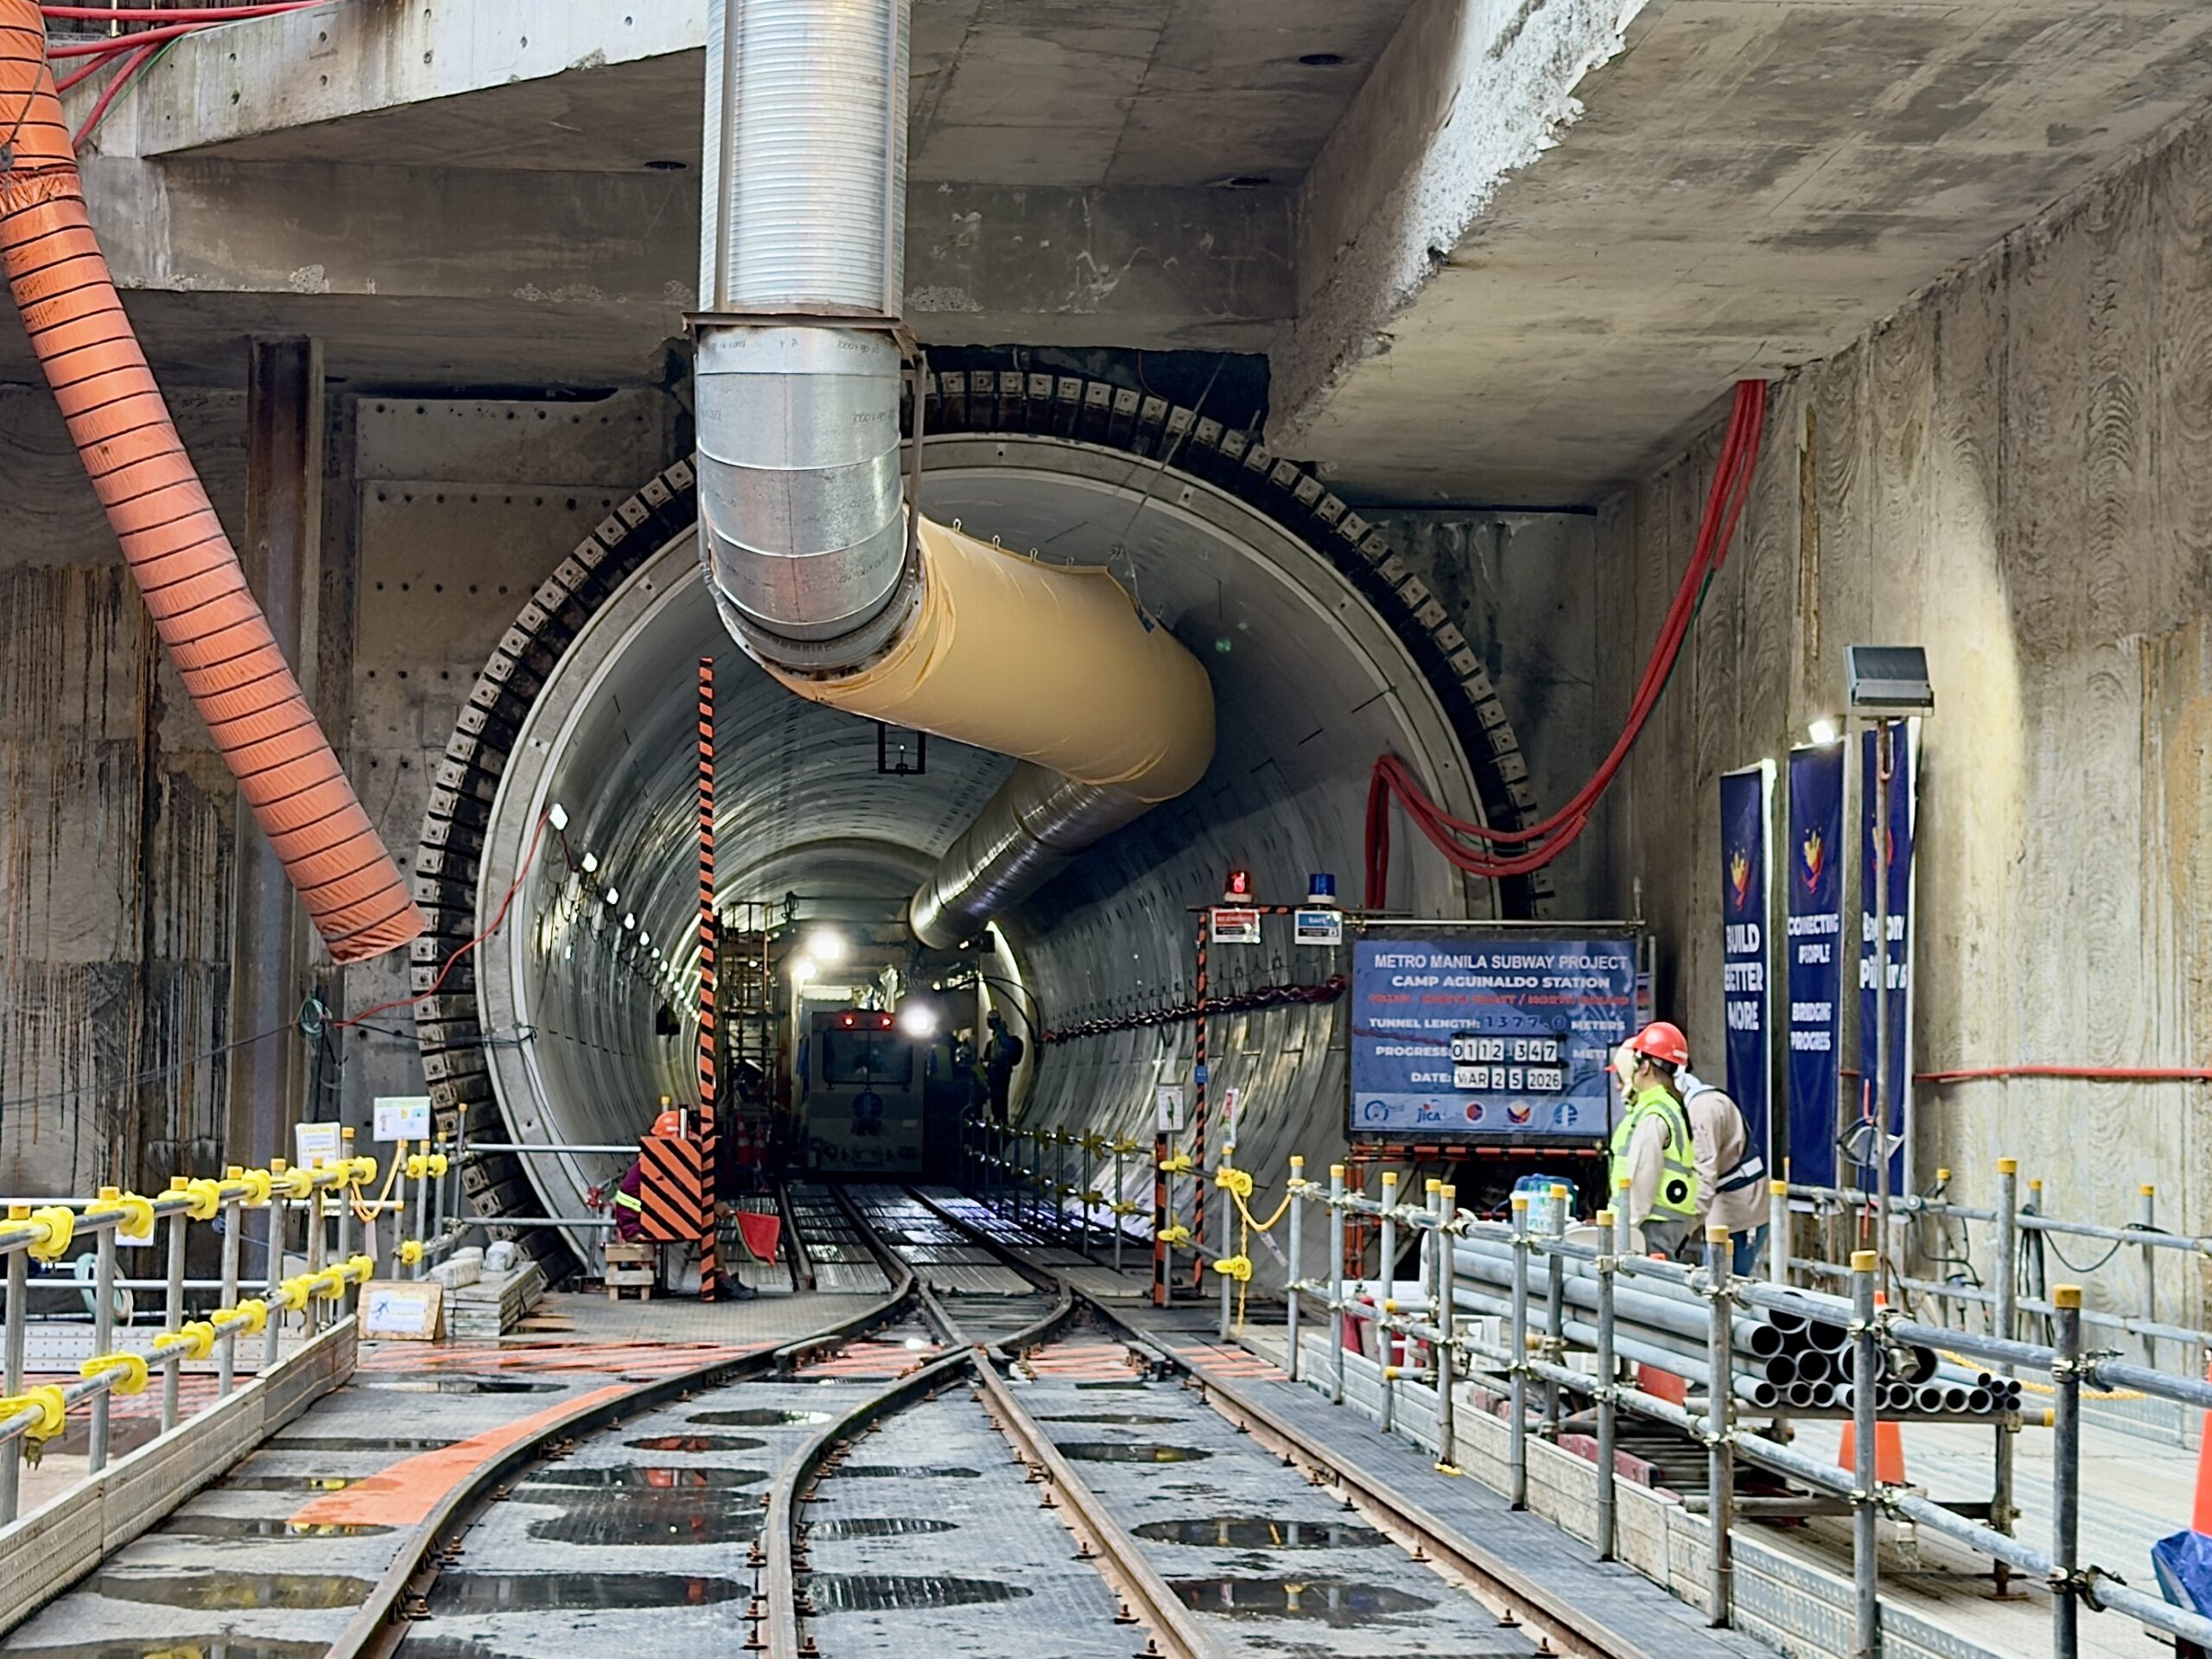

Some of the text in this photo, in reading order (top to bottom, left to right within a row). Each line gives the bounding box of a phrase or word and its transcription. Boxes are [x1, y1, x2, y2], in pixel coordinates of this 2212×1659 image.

[1726, 923, 1760, 953] BUILD
[1374, 954, 1629, 970] METRO MANILA SUBWAY PROJECT
[1391, 976, 1611, 988] CAMP AGUINALDO STATION
[1724, 962, 1764, 992] BETTER
[1728, 1001, 1759, 1030] MORE
[1369, 1018, 1421, 1028] TUNNEL
[1424, 1018, 1481, 1029] LENGTH:
[1571, 1020, 1625, 1031] METERS
[1411, 1072, 1452, 1083] DATE:
[1457, 1072, 1487, 1085] MAR
[1529, 1073, 1560, 1087] 2026
